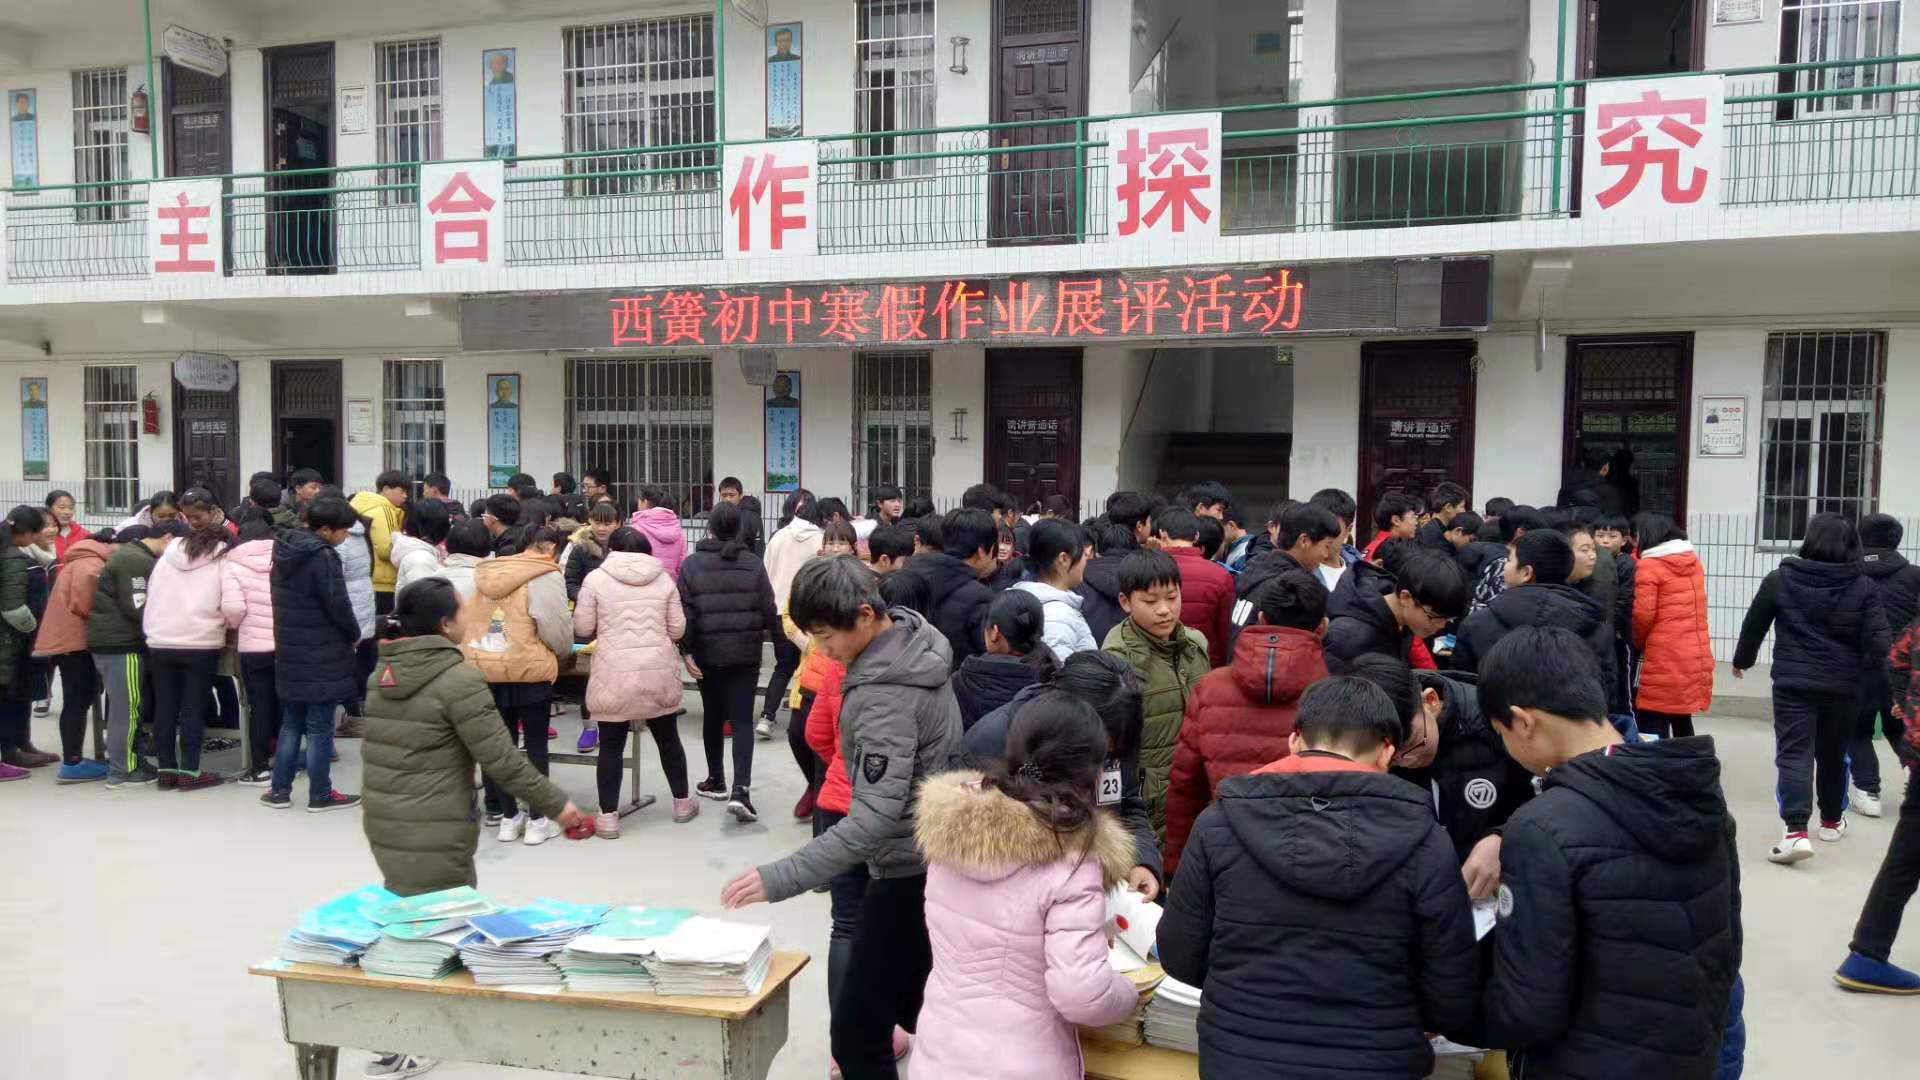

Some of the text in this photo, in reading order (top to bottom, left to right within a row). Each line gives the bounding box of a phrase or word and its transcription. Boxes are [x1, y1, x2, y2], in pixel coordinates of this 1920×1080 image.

[155, 91, 1708, 272] 主 合 作 探 究
[609, 269, 1304, 347] 西簧初中寒假作业展评活动
[1103, 779, 1119, 795] 23
